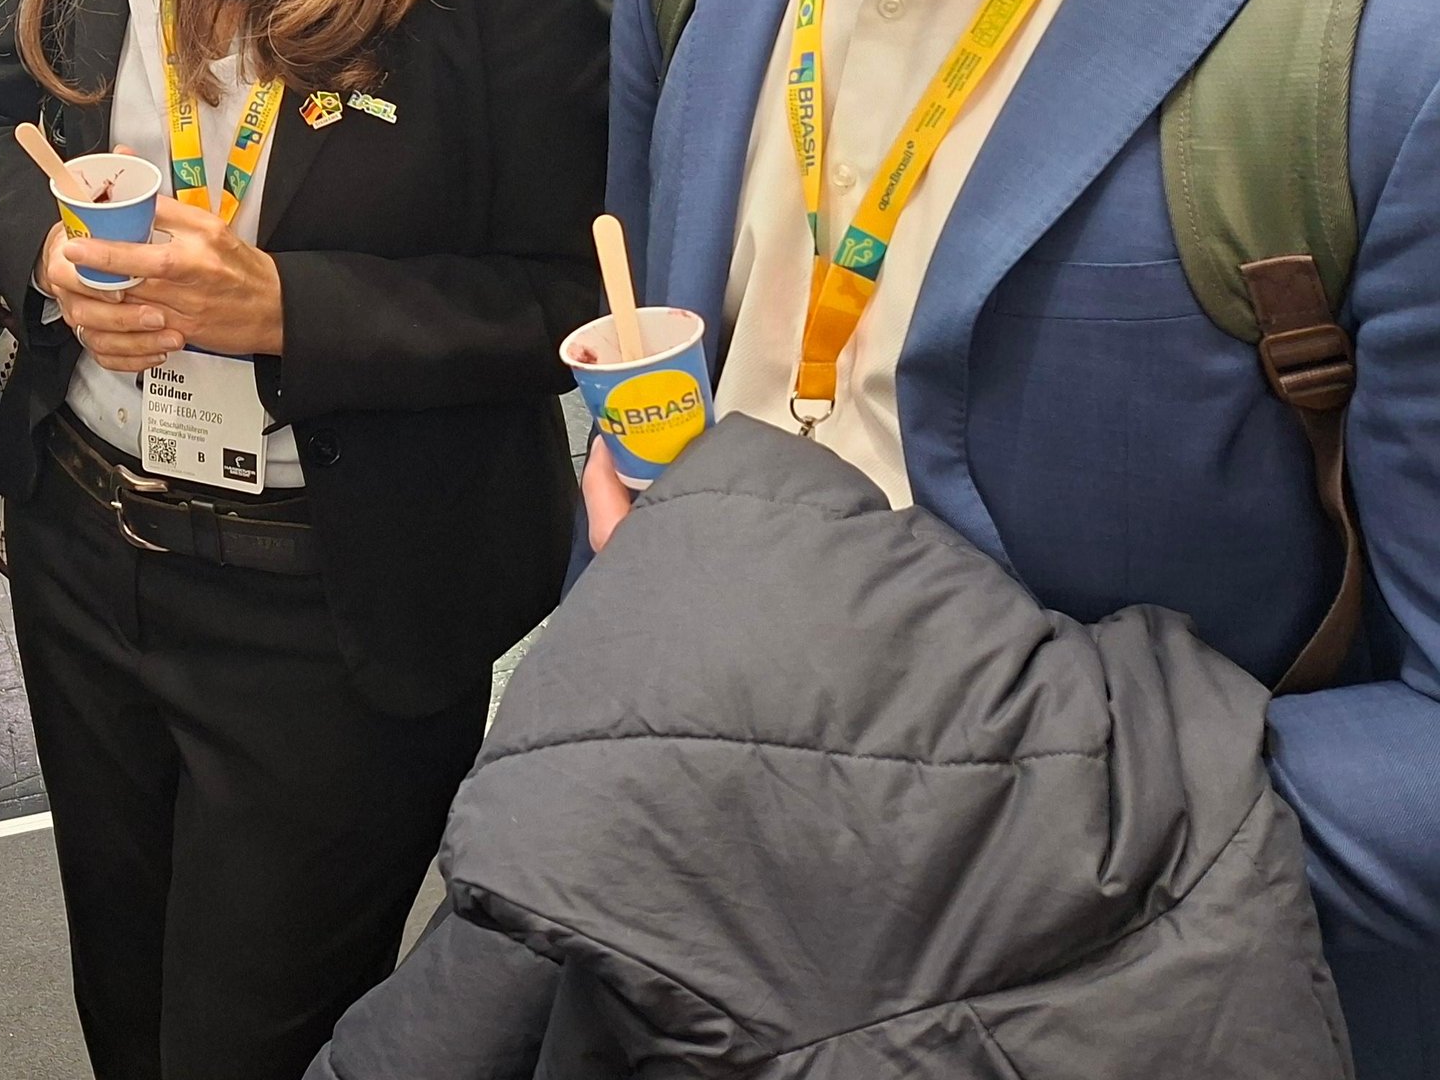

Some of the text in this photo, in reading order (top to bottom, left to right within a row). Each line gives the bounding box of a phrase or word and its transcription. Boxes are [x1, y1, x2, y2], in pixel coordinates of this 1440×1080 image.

[245, 79, 273, 127] BRAS
[798, 87, 815, 176] BRASIL
[150, 367, 185, 384] Ulrike
[149, 383, 193, 401] Göldner
[148, 400, 223, 425] DBWT-EEBA 2026
[624, 387, 700, 425] BRASI
[198, 452, 206, 463] B
